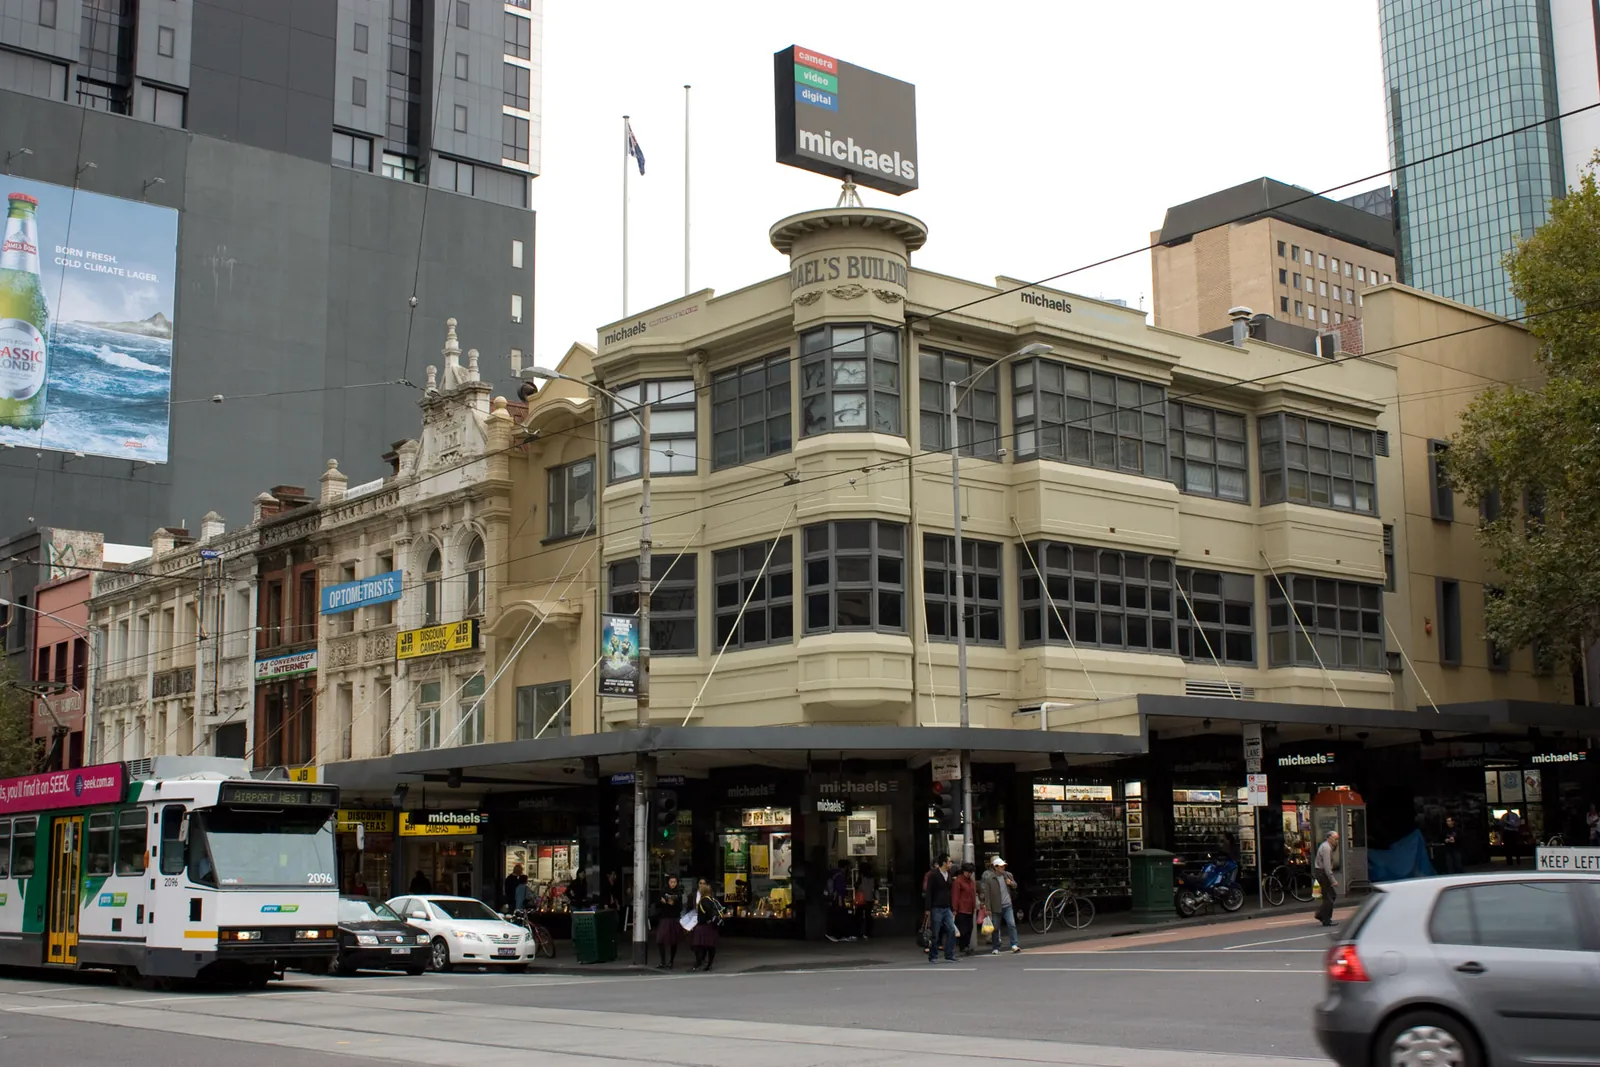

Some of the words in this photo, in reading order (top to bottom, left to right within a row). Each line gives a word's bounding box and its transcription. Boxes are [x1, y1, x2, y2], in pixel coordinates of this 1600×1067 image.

[799, 52, 833, 69] camera
[803, 71, 829, 86] video
[802, 89, 831, 105] digital
[800, 129, 915, 180] michaels
[55, 245, 83, 257] BORN
[85, 251, 118, 264] FRESH.
[54, 257, 82, 268] COLD
[83, 262, 125, 277] CLIMATE
[127, 270, 160, 282] LAGER.
[1021, 291, 1072, 314] michaels
[604, 321, 647, 346] michaels
[0, 346, 44, 363] ASSIC
[329, 577, 394, 608] OPTOMETRISTS
[420, 626, 447, 642] DISCOUNT
[455, 622, 469, 635] JB
[401, 633, 413, 645] JB
[420, 639, 447, 654] CAMERAS
[270, 652, 315, 667] CONVENIENCE
[259, 661, 269, 673] 24
[274, 660, 309, 674] INTERNET
[1278, 753, 1327, 767] michaels
[1531, 752, 1579, 764] michaels
[297, 769, 308, 781] JB
[23, 778, 36, 797] find
[36, 779, 40, 795] it
[41, 781, 49, 794] on
[83, 776, 115, 790] seek.com.au
[820, 780, 888, 793] michaels
[234, 790, 275, 802] AIRPORT
[279, 791, 302, 804] WEST
[728, 784, 769, 797] michaels
[816, 799, 842, 813] michaels
[347, 811, 386, 821] DISCOUNT
[428, 812, 481, 824] michaels
[424, 825, 449, 834] CAMERAS
[1541, 855, 1570, 868] KEEP
[1574, 855, 1600, 869] LEFT
[164, 878, 179, 887] 2096
[307, 872, 333, 884] 2096
